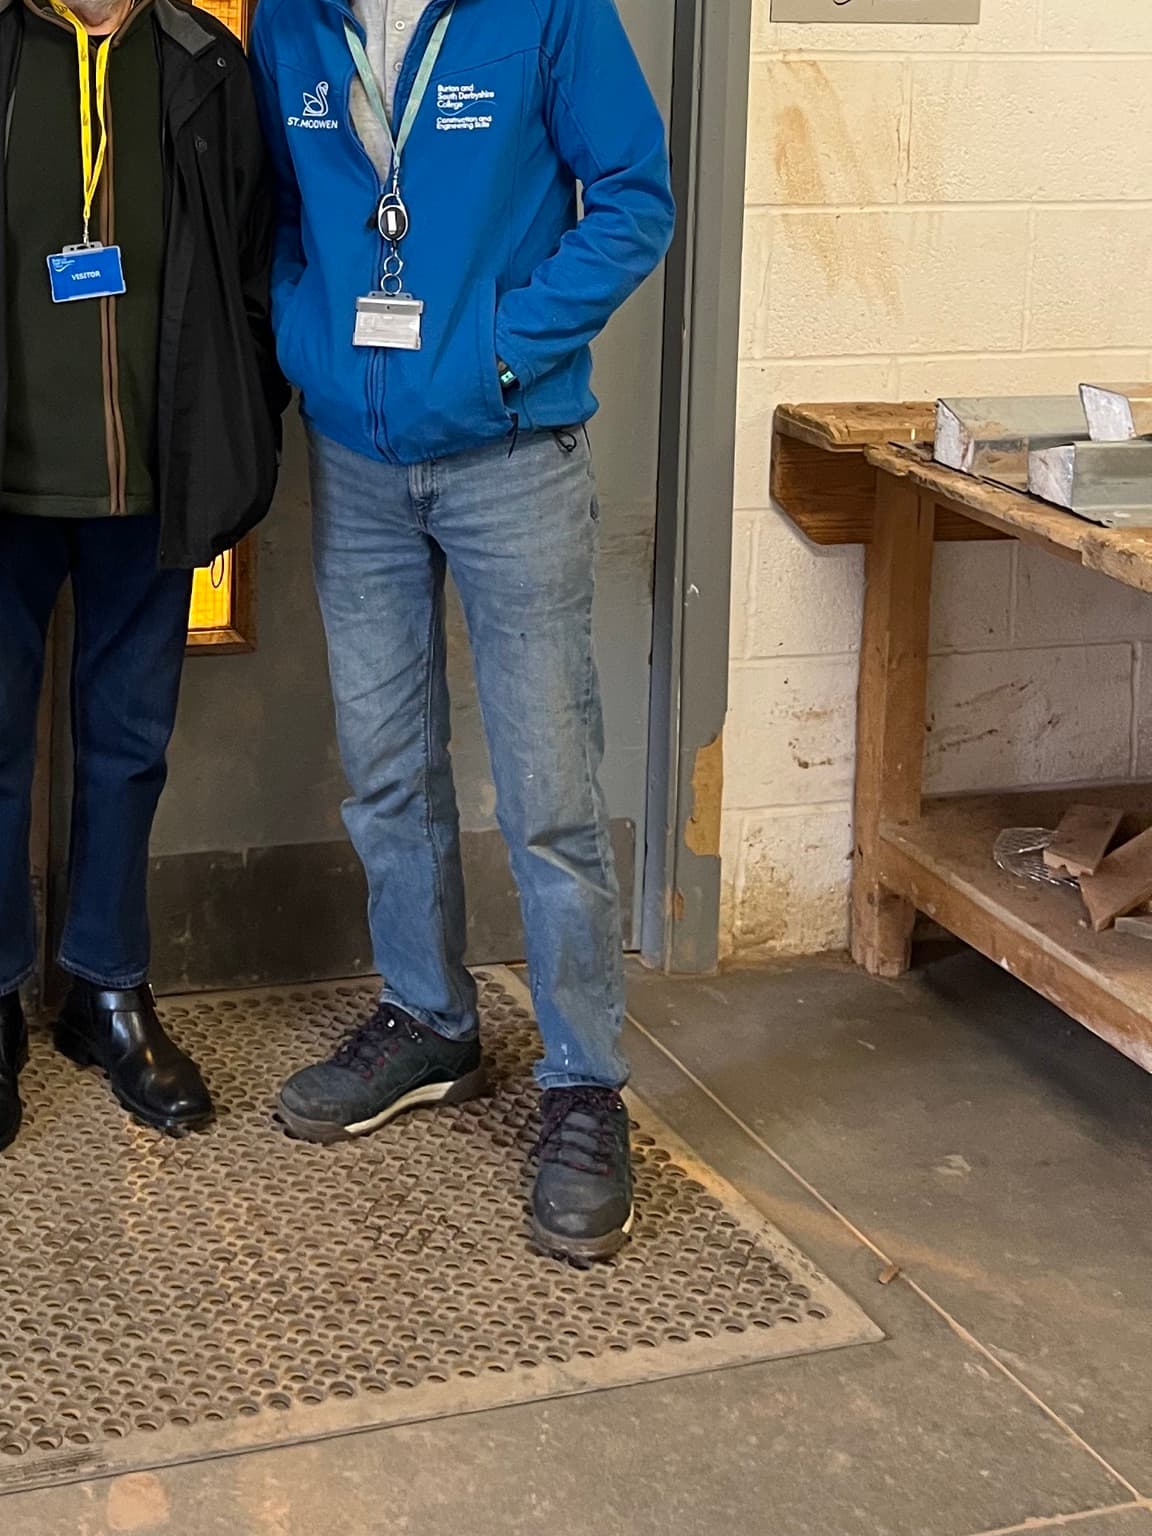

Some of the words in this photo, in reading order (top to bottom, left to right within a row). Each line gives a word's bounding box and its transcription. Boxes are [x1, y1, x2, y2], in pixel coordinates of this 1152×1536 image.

[437, 84, 460, 93] Burton
[460, 83, 474, 92] and
[437, 91, 458, 100] South
[458, 89, 495, 101] Derbyshire
[436, 100, 464, 110] College
[287, 116, 338, 129] ST.MODWEN
[71, 270, 102, 281] VISITOR
